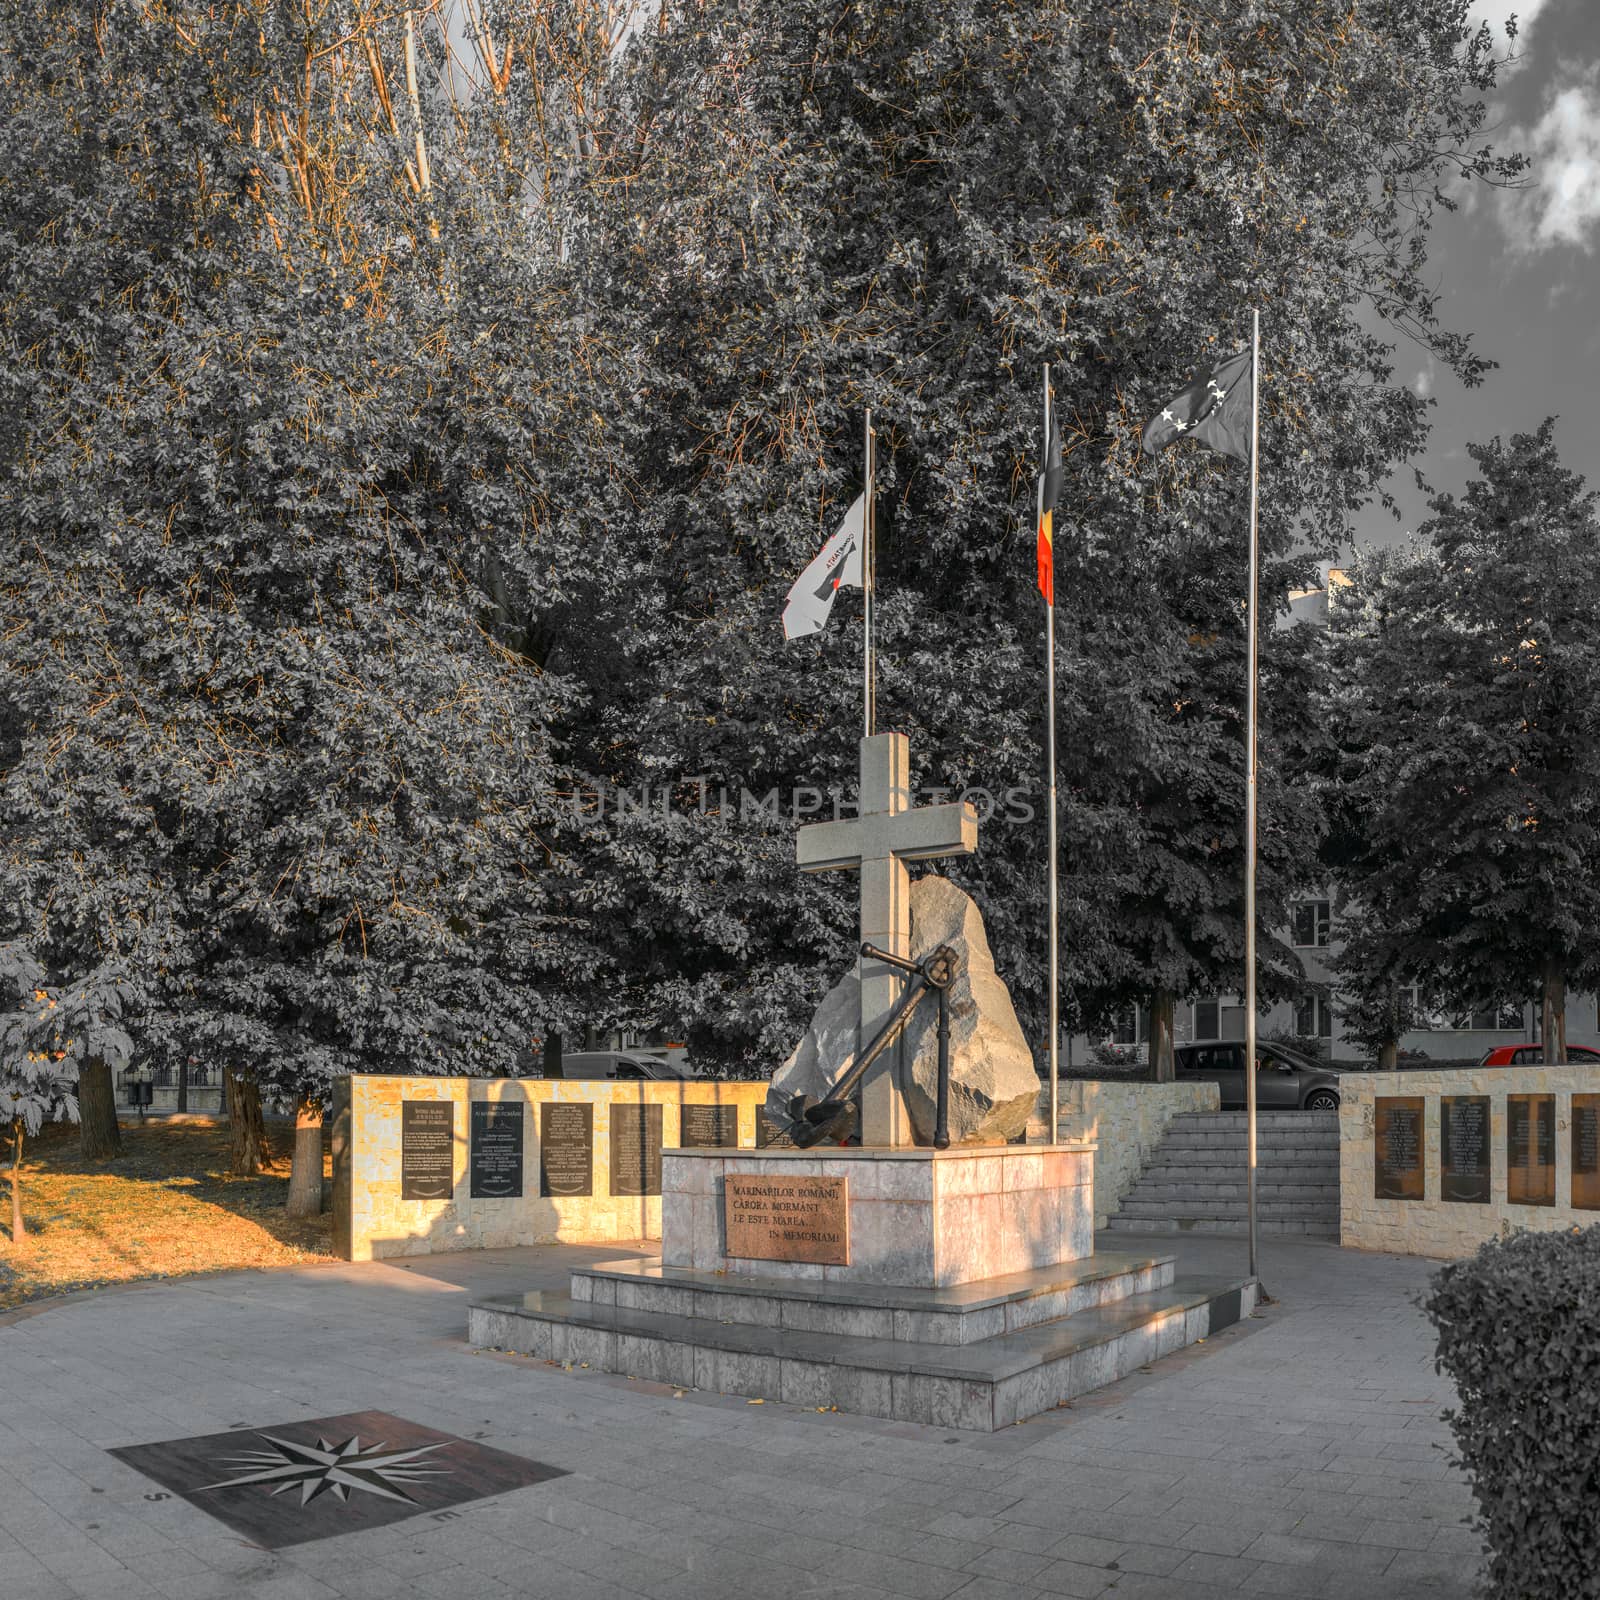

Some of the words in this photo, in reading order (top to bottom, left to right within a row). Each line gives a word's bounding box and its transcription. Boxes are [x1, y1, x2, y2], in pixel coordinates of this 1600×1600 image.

[733, 1186, 795, 1198] MARINARILOR
[733, 1214, 745, 1223] LE
[748, 1214, 769, 1224] ESTE
[143, 1492, 172, 1503] S
[430, 1511, 461, 1523] E
